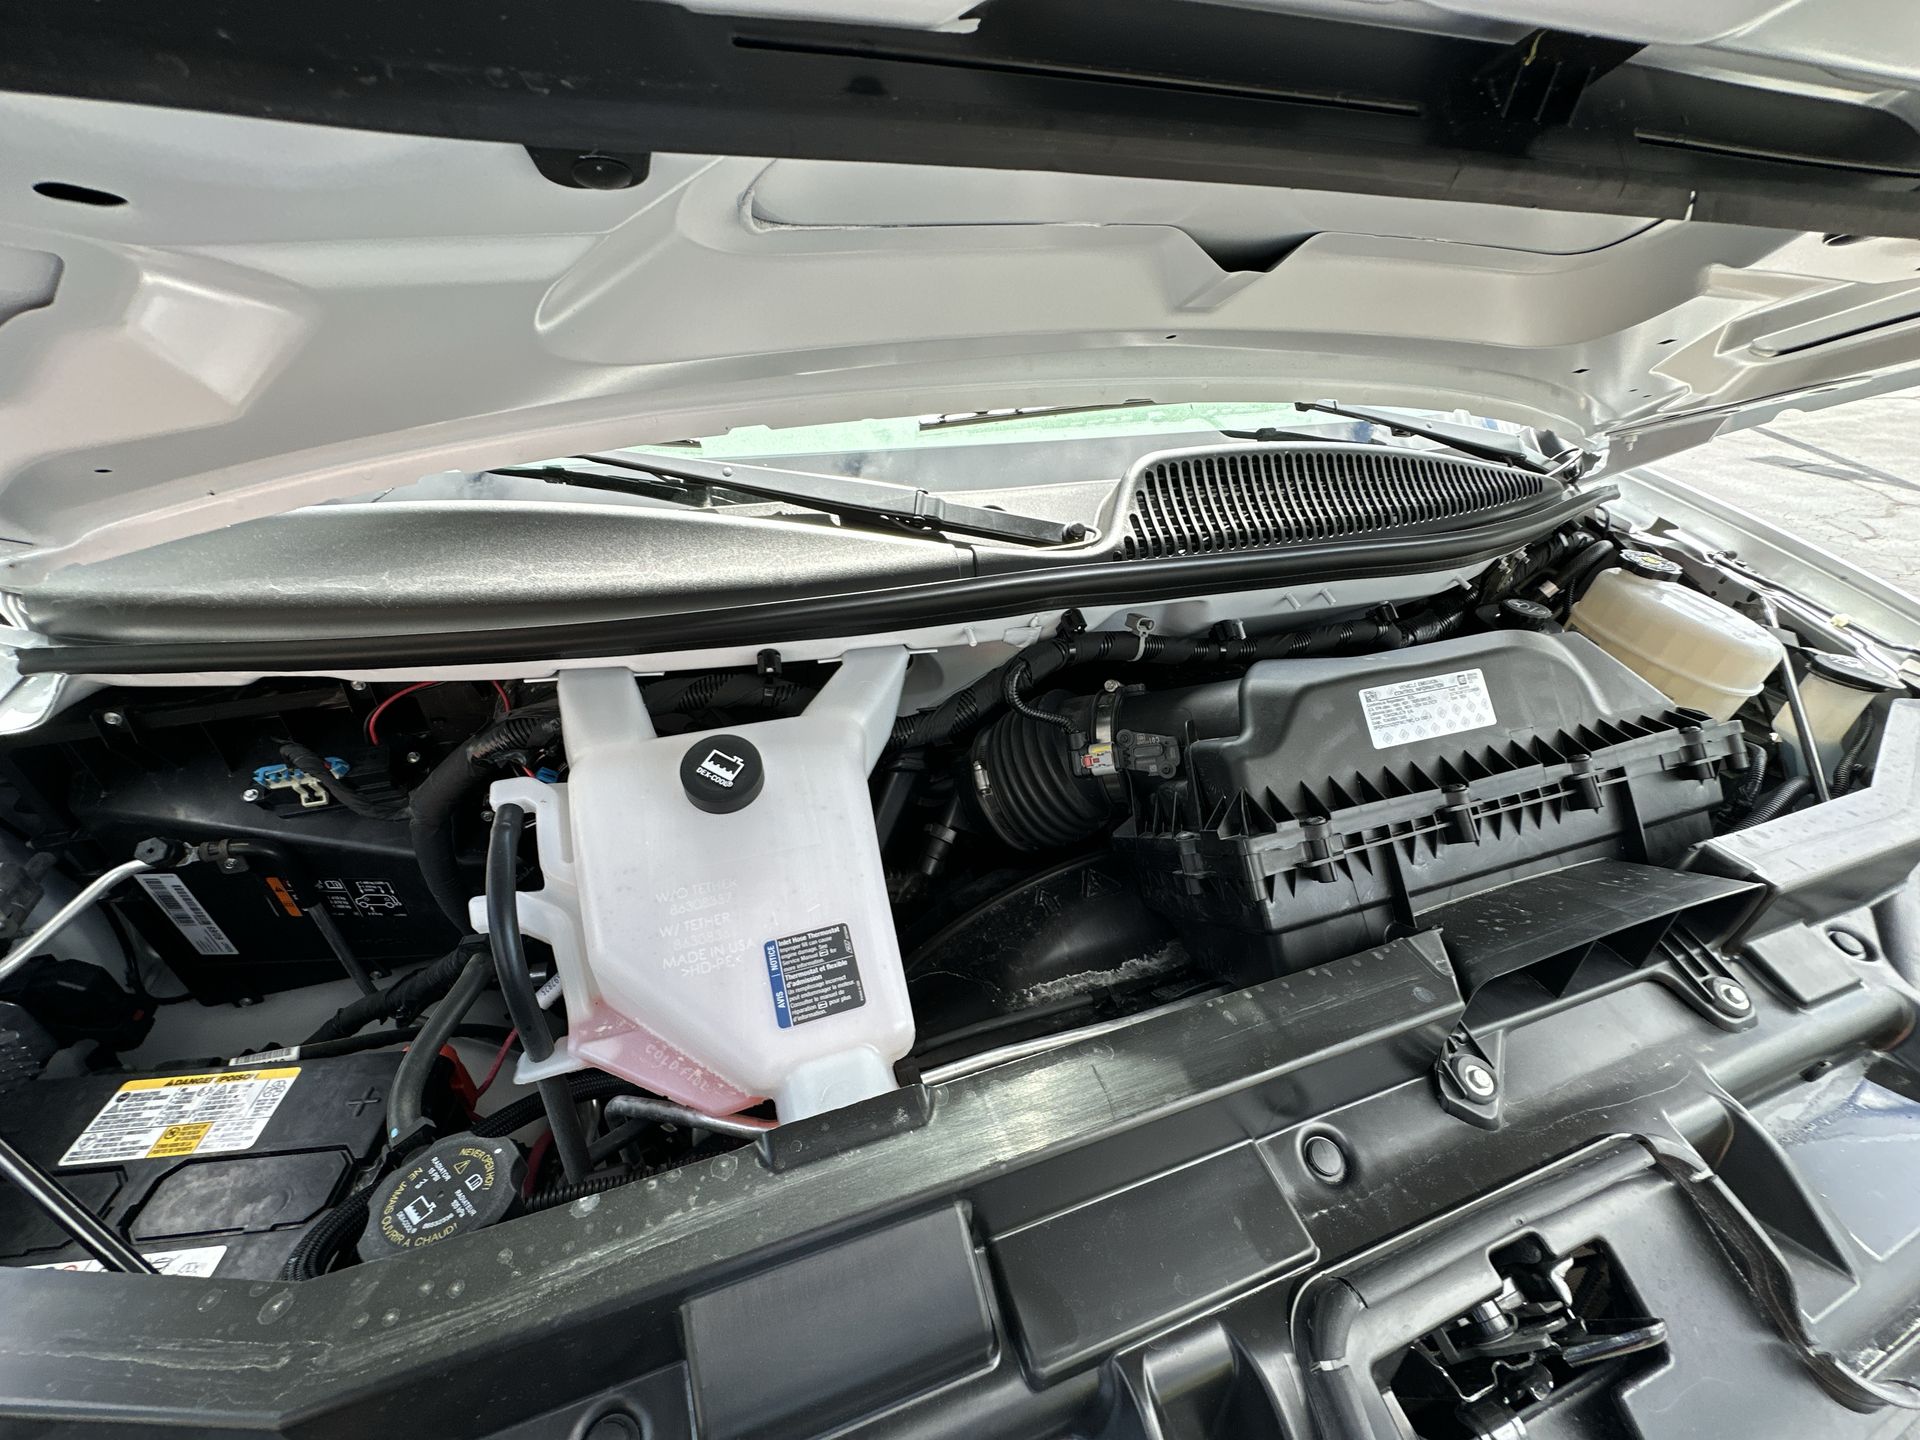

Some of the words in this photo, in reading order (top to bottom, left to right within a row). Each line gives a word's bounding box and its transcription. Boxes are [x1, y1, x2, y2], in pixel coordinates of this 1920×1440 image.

[683, 911, 731, 931] TETHER
[792, 935, 807, 944] Hose
[807, 926, 840, 940] Thermostat
[662, 947, 708, 970] MADE
[710, 942, 725, 958] IN
[728, 937, 758, 954] USA
[767, 945, 779, 971] NOTICE
[785, 967, 819, 981] Thermostat
[819, 965, 826, 973] et
[826, 959, 848, 970] flexible
[775, 991, 786, 1009] AVIS
[431, 1156, 452, 1182] RADIATOR
[459, 1147, 484, 1160] NEVER
[481, 1154, 495, 1172] OPEN
[384, 1180, 408, 1215] JAMAIS
[454, 1189, 477, 1216] RADIATEUR
[381, 1215, 405, 1245] OUVRIR
